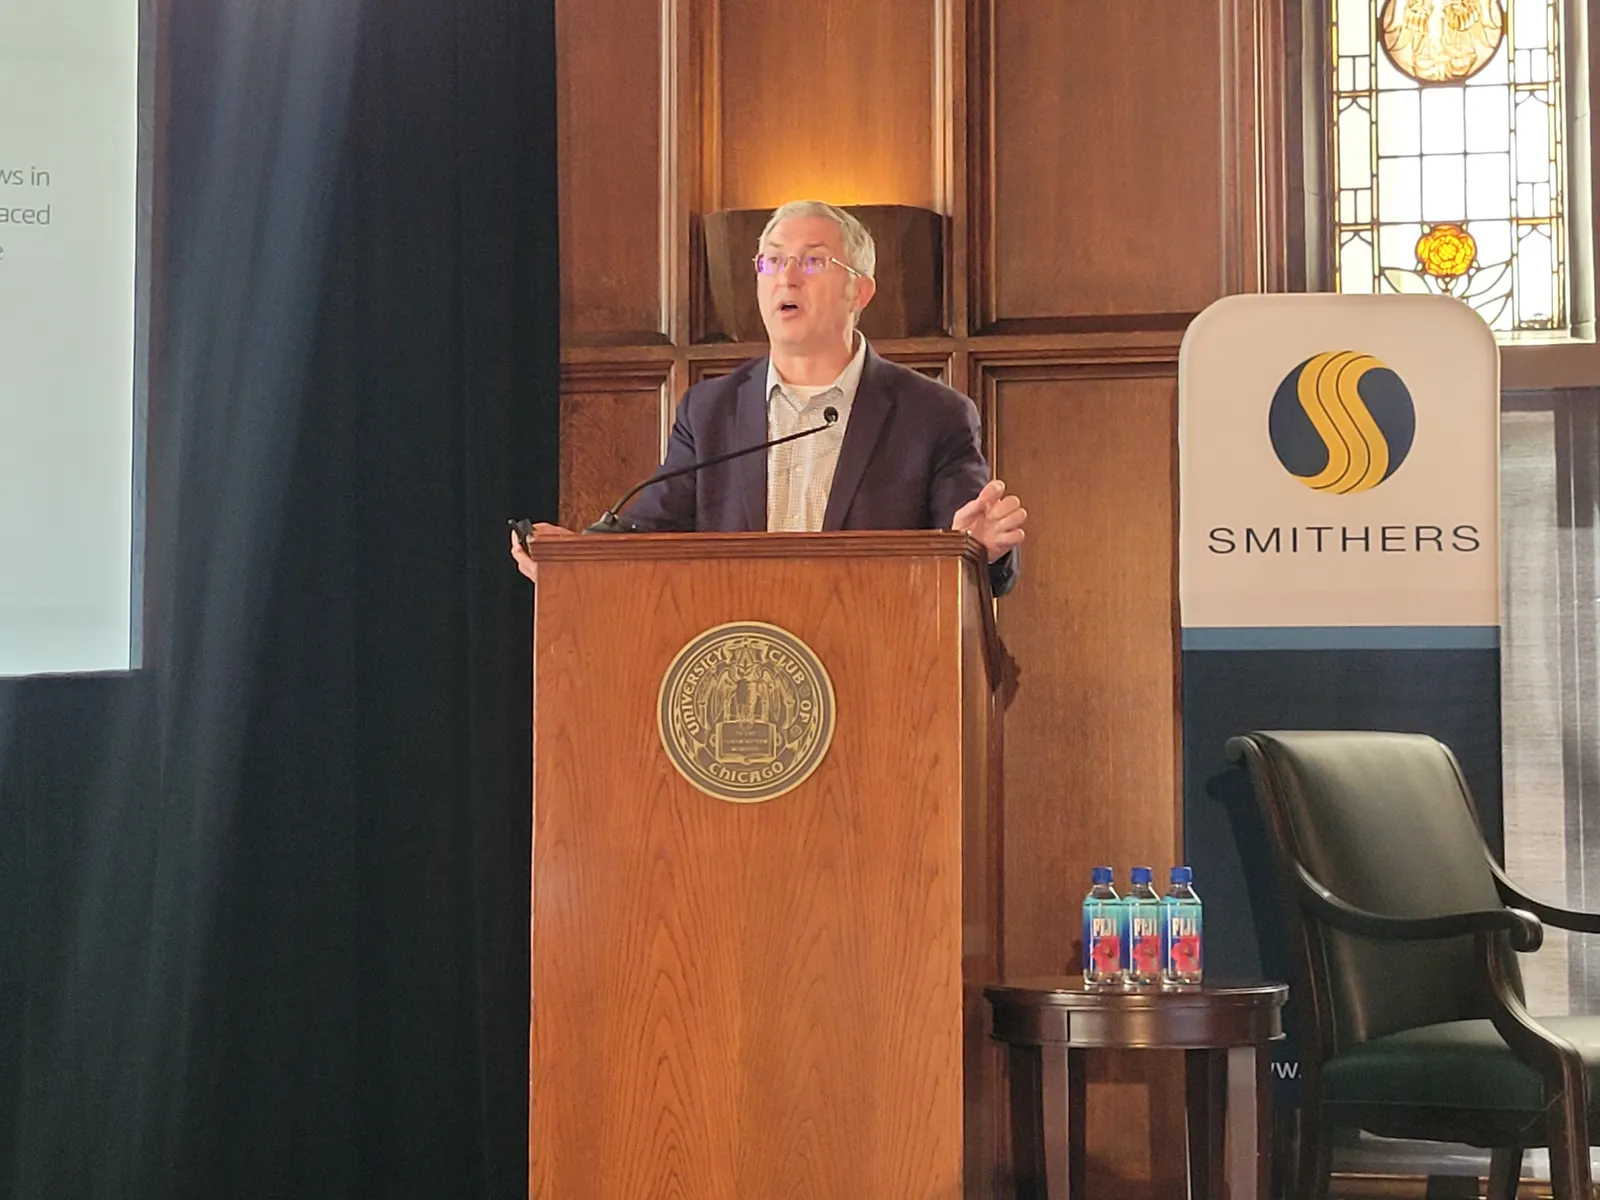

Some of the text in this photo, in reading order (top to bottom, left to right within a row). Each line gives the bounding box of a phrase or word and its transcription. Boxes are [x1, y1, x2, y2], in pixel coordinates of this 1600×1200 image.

[31, 166, 50, 186] in
[1208, 525, 1480, 554] SMITHERS
[681, 648, 812, 736] UNIVERSITY CLUB OF
[709, 761, 784, 783] CHICAGO
